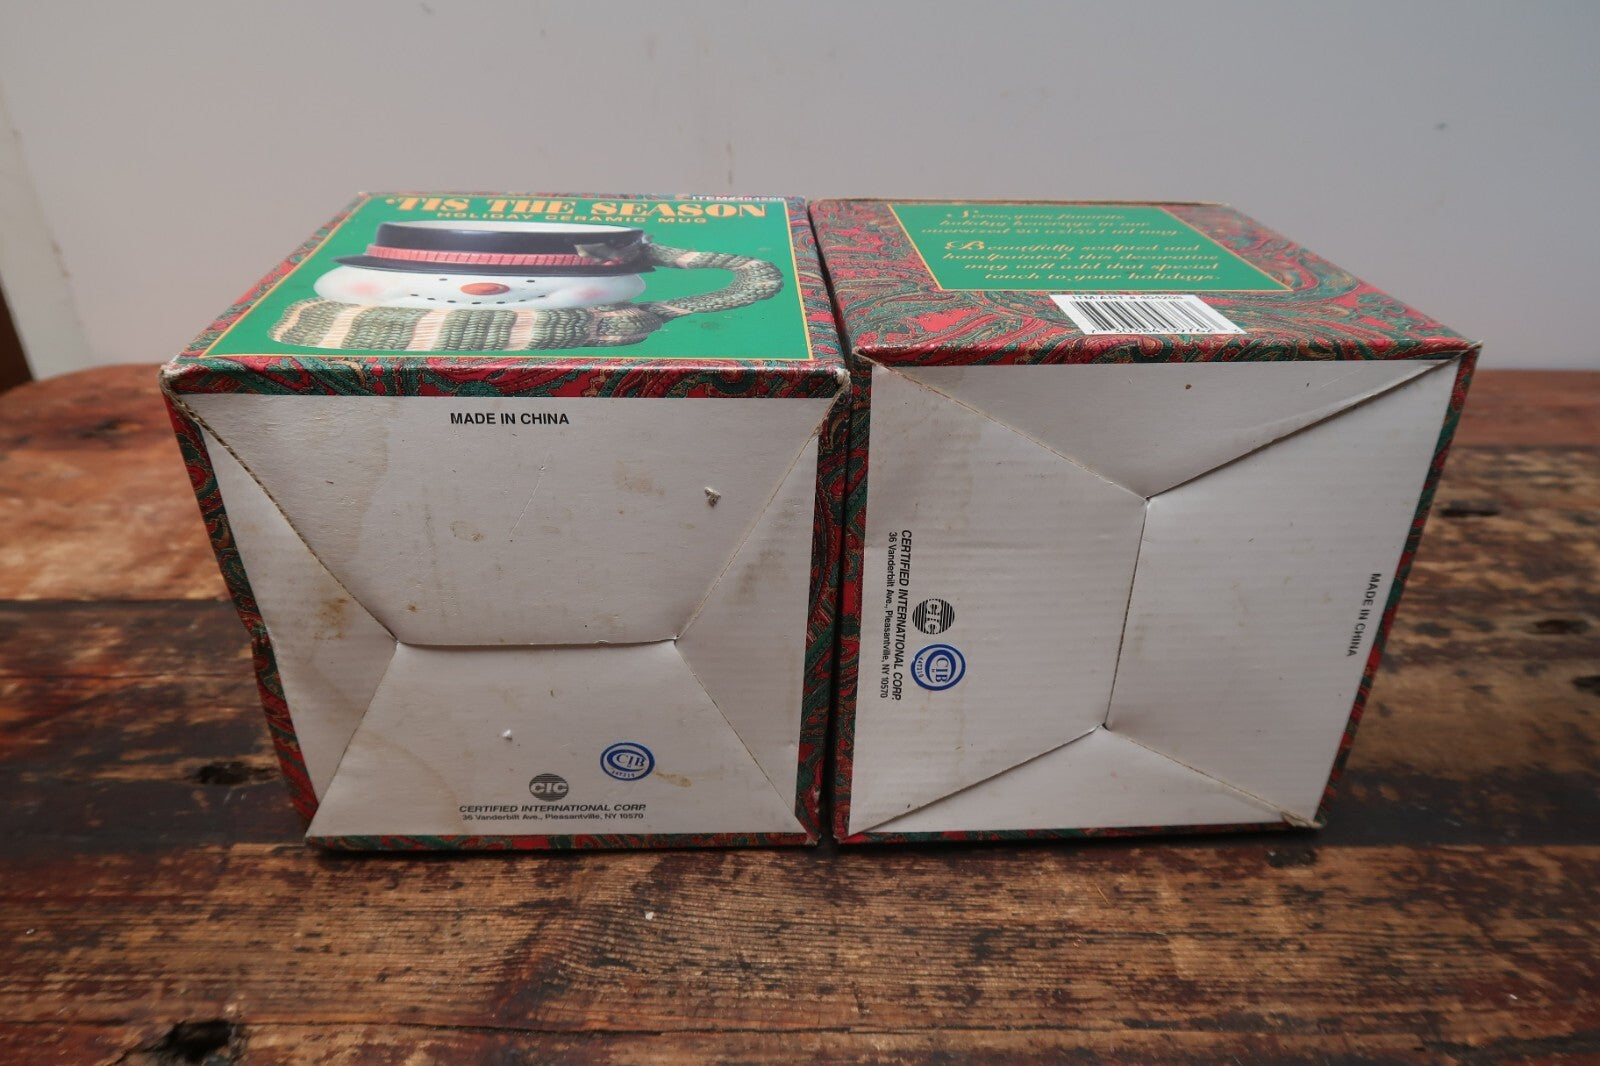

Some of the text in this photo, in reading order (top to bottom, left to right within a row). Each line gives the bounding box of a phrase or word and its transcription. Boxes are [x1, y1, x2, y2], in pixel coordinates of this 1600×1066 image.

[486, 199, 576, 214] THE
[590, 201, 767, 218] SEASON
[437, 212, 534, 220] HOLIDAY
[545, 214, 646, 223] CERAMIC
[944, 240, 1075, 252] Beautifully
[1081, 244, 1160, 253] sculpted
[1151, 262, 1219, 272] special
[1128, 272, 1220, 282] holidays.
[450, 412, 569, 425] MADE IN CHINA
[888, 532, 898, 542] 36
[886, 545, 897, 587] Vanderbilt
[891, 529, 912, 701] CERTIFIED INTERNATIONAL CORP.
[1346, 573, 1382, 657] MADE IN CHINA
[881, 610, 893, 662] Pleasantville,
[883, 663, 890, 675] NY
[880, 676, 889, 699] 10570
[530, 782, 569, 794] CIC
[459, 805, 519, 813] CERTIFIED
[521, 804, 610, 812] INTERNATIONAL
[545, 813, 603, 821] Pleasantville,
